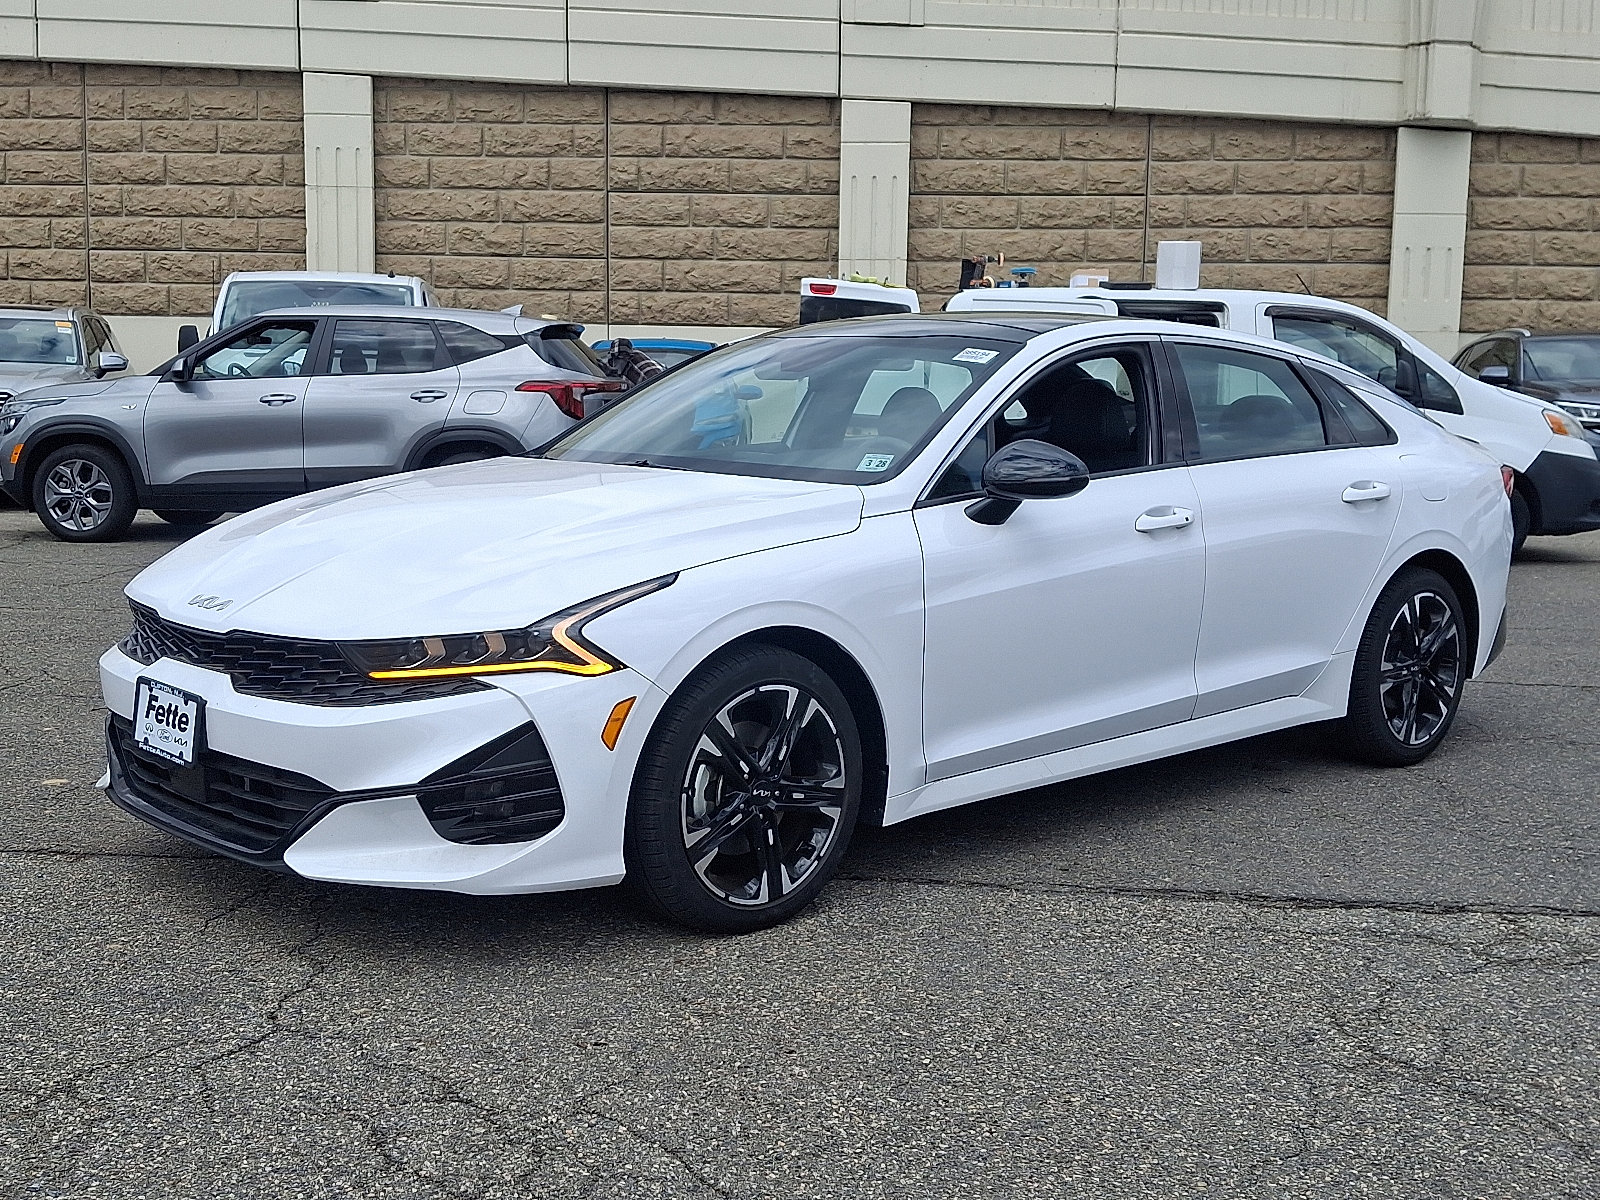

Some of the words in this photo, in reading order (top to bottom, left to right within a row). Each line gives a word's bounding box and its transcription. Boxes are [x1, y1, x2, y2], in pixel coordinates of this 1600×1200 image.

[865, 459, 873, 467] 3
[875, 459, 888, 468] 28
[187, 594, 233, 611] KIA
[144, 693, 190, 733] Fette
[173, 736, 188, 747] KIA
